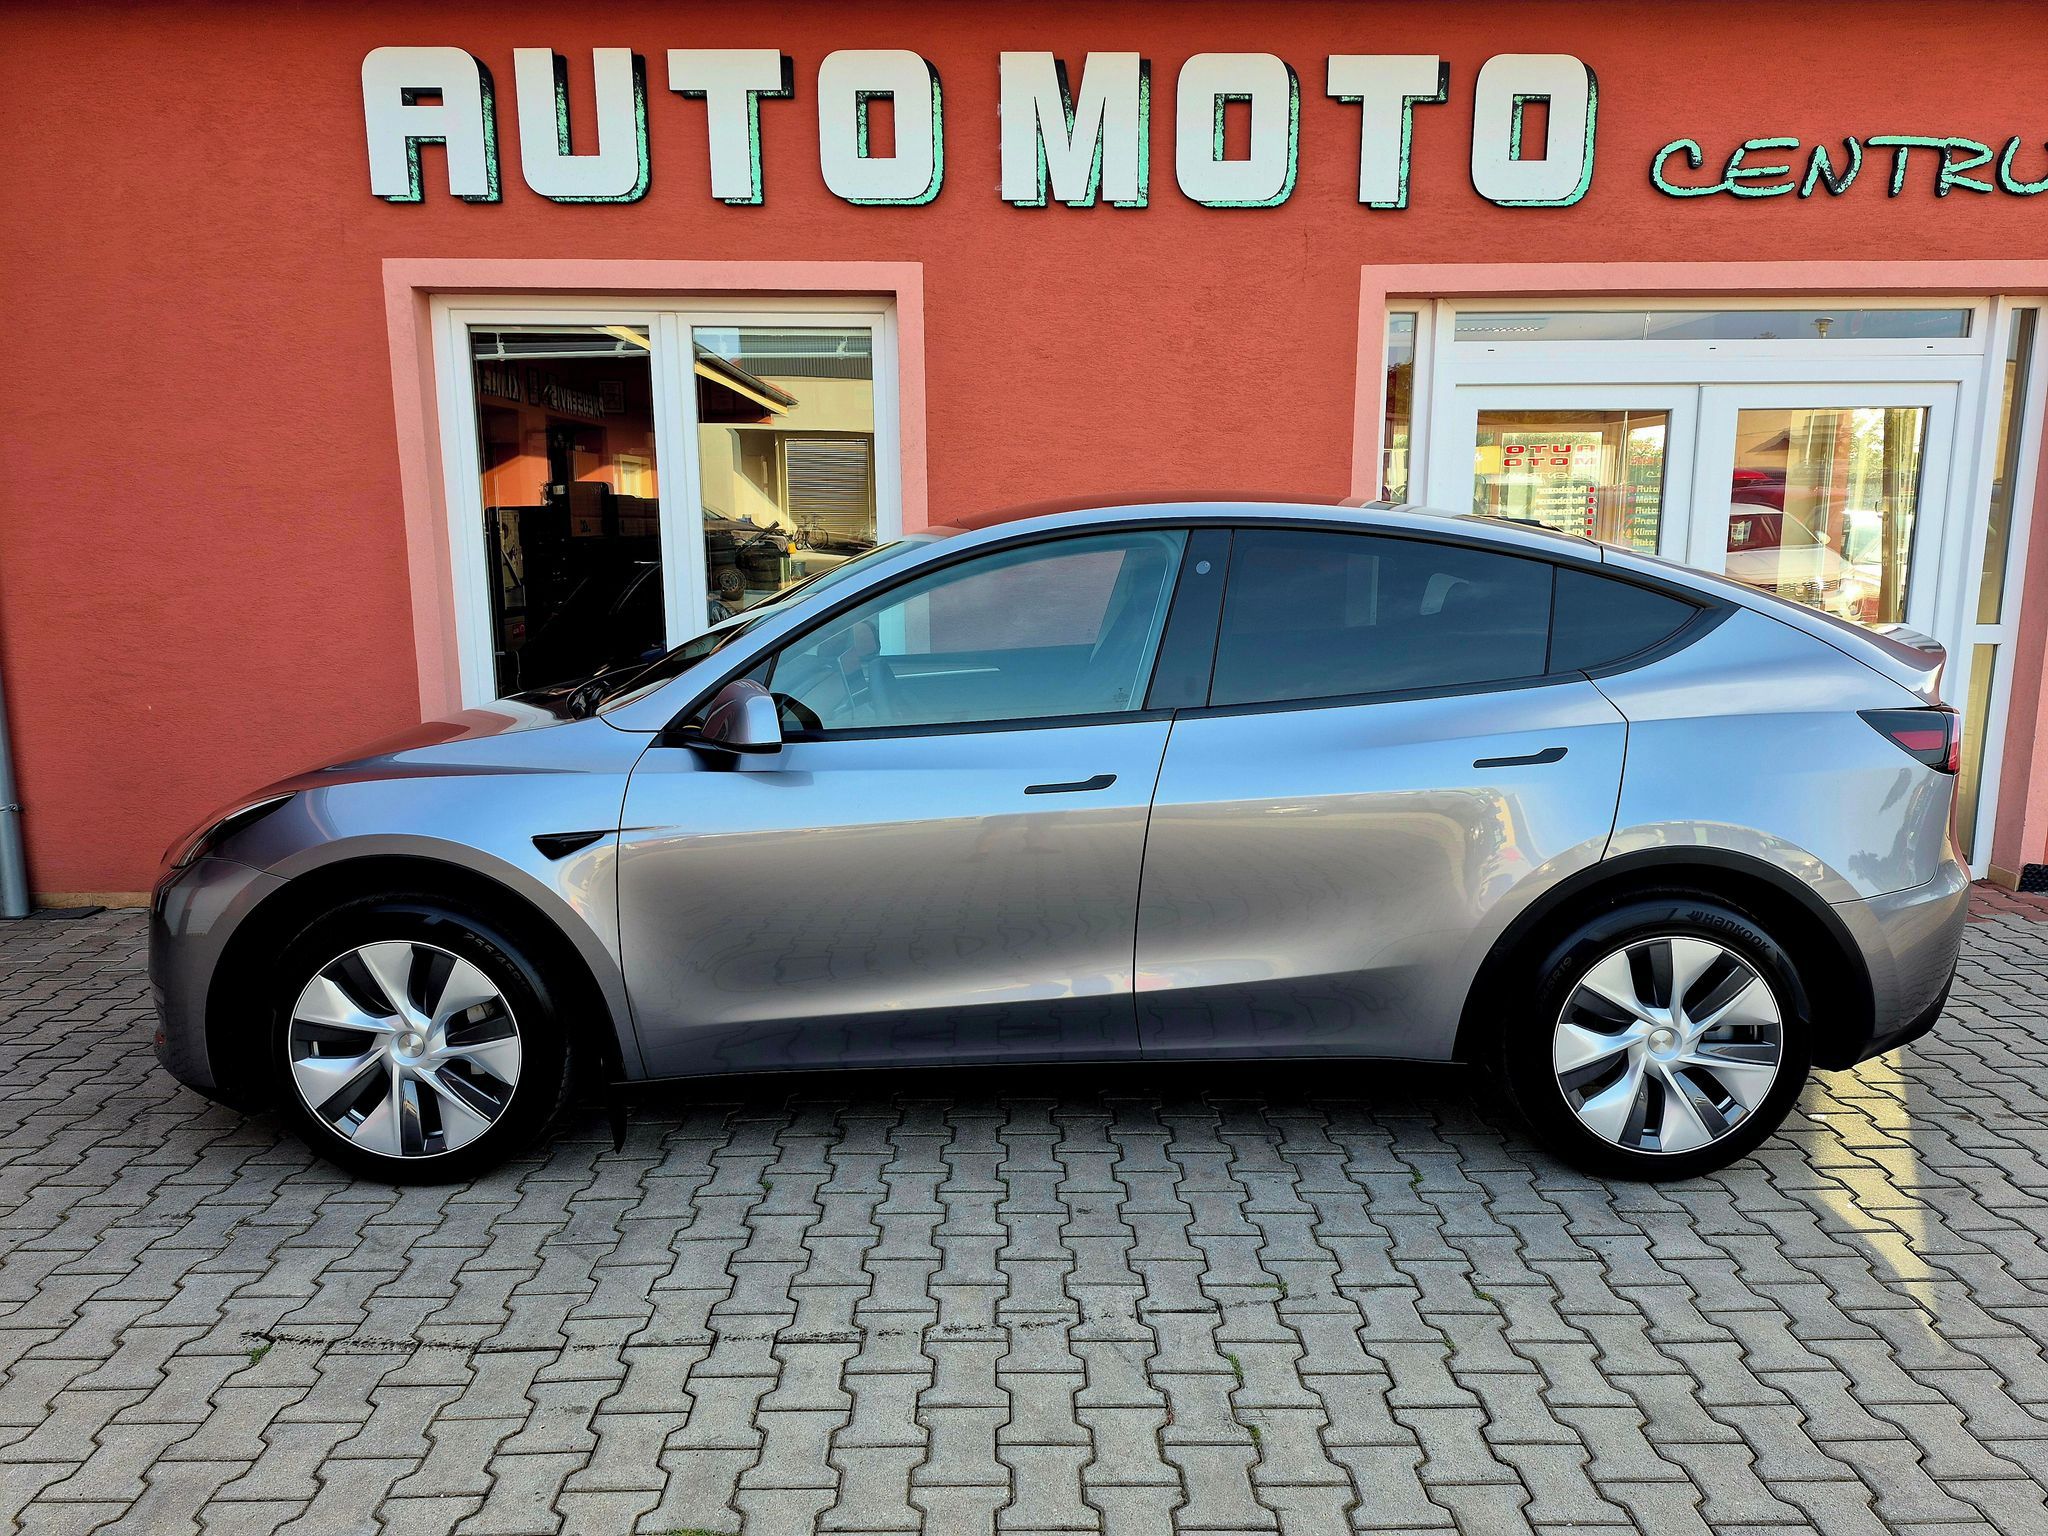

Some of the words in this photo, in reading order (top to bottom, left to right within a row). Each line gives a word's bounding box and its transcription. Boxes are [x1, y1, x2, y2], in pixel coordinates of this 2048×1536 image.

[361, 46, 944, 206] AUTO
[998, 51, 1598, 208] MOTO
[1648, 134, 2048, 200] CENTRU
[1635, 506, 1659, 515] Auto
[1703, 912, 1771, 951] Hankook
